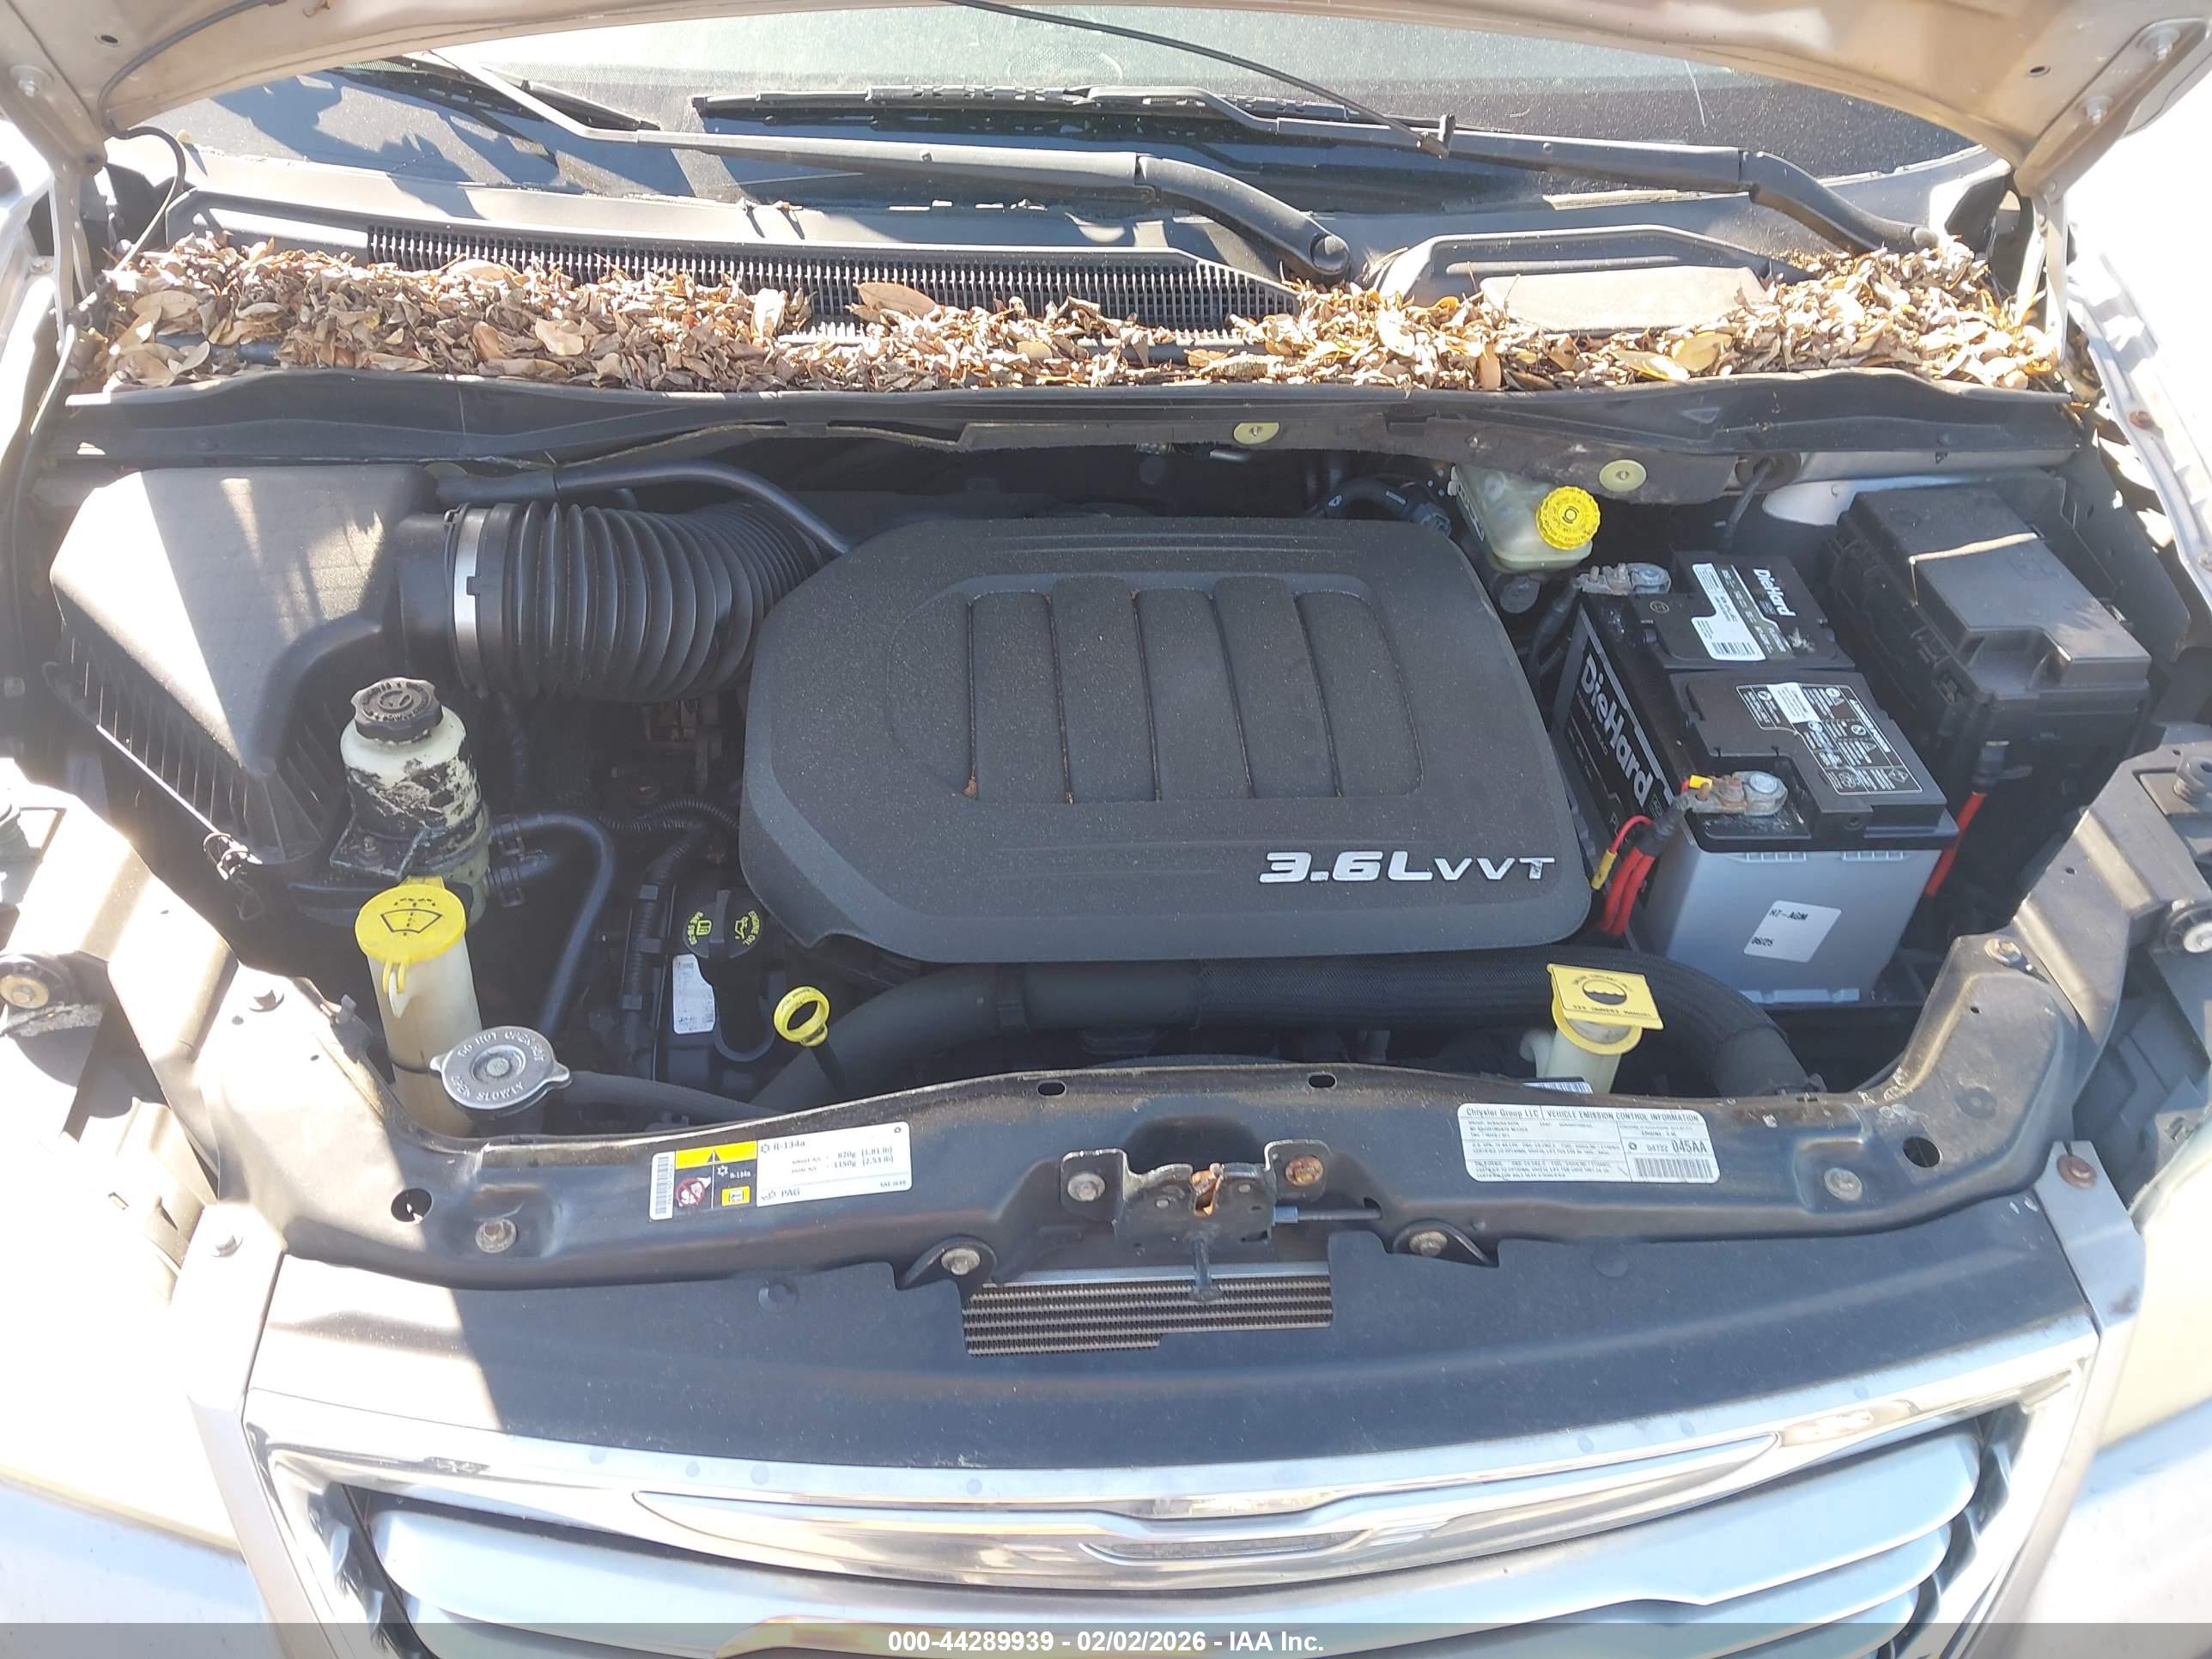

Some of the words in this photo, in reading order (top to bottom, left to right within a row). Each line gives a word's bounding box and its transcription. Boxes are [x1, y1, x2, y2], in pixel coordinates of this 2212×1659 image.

[1753, 568, 1796, 617] DieHard
[1581, 652, 1654, 808] DieHard
[457, 1043, 473, 1058] DO
[475, 1030, 497, 1045] NOT
[505, 1030, 531, 1045] OPEN
[477, 1081, 525, 1101] SLOWLY
[1467, 1108, 1497, 1118] Chrysler
[1500, 1108, 1522, 1119] Group
[1524, 1109, 1538, 1117] LLC
[1547, 1109, 1576, 1118] VEHICLE
[1579, 1110, 1613, 1119] EMISSION
[1615, 1112, 1648, 1121] CONTROL
[1650, 1113, 1698, 1121] INFORMATION
[1671, 1139, 1708, 1153] 045AA
[781, 1188, 800, 1198] PAG
